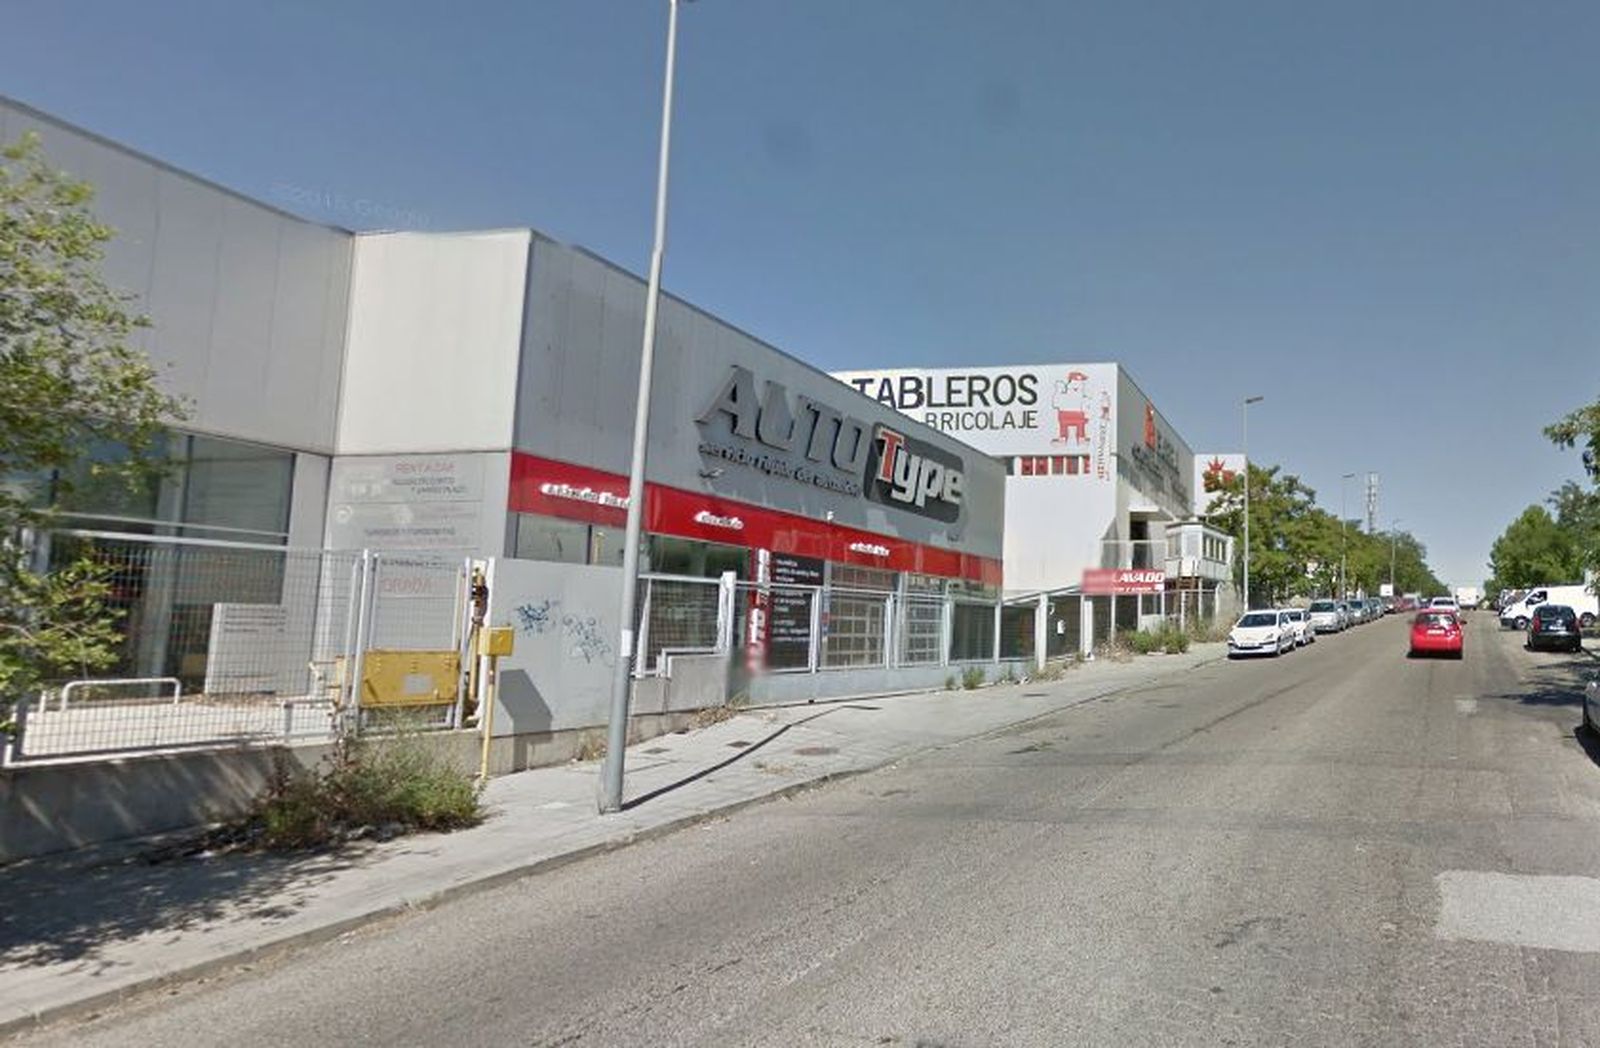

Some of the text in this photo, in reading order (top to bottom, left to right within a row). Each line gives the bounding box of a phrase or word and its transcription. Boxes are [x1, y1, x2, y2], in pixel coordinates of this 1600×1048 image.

[852, 374, 1038, 409] TABLEROS
[926, 410, 1038, 430] BRICOLAJE
[877, 427, 963, 507] Type
